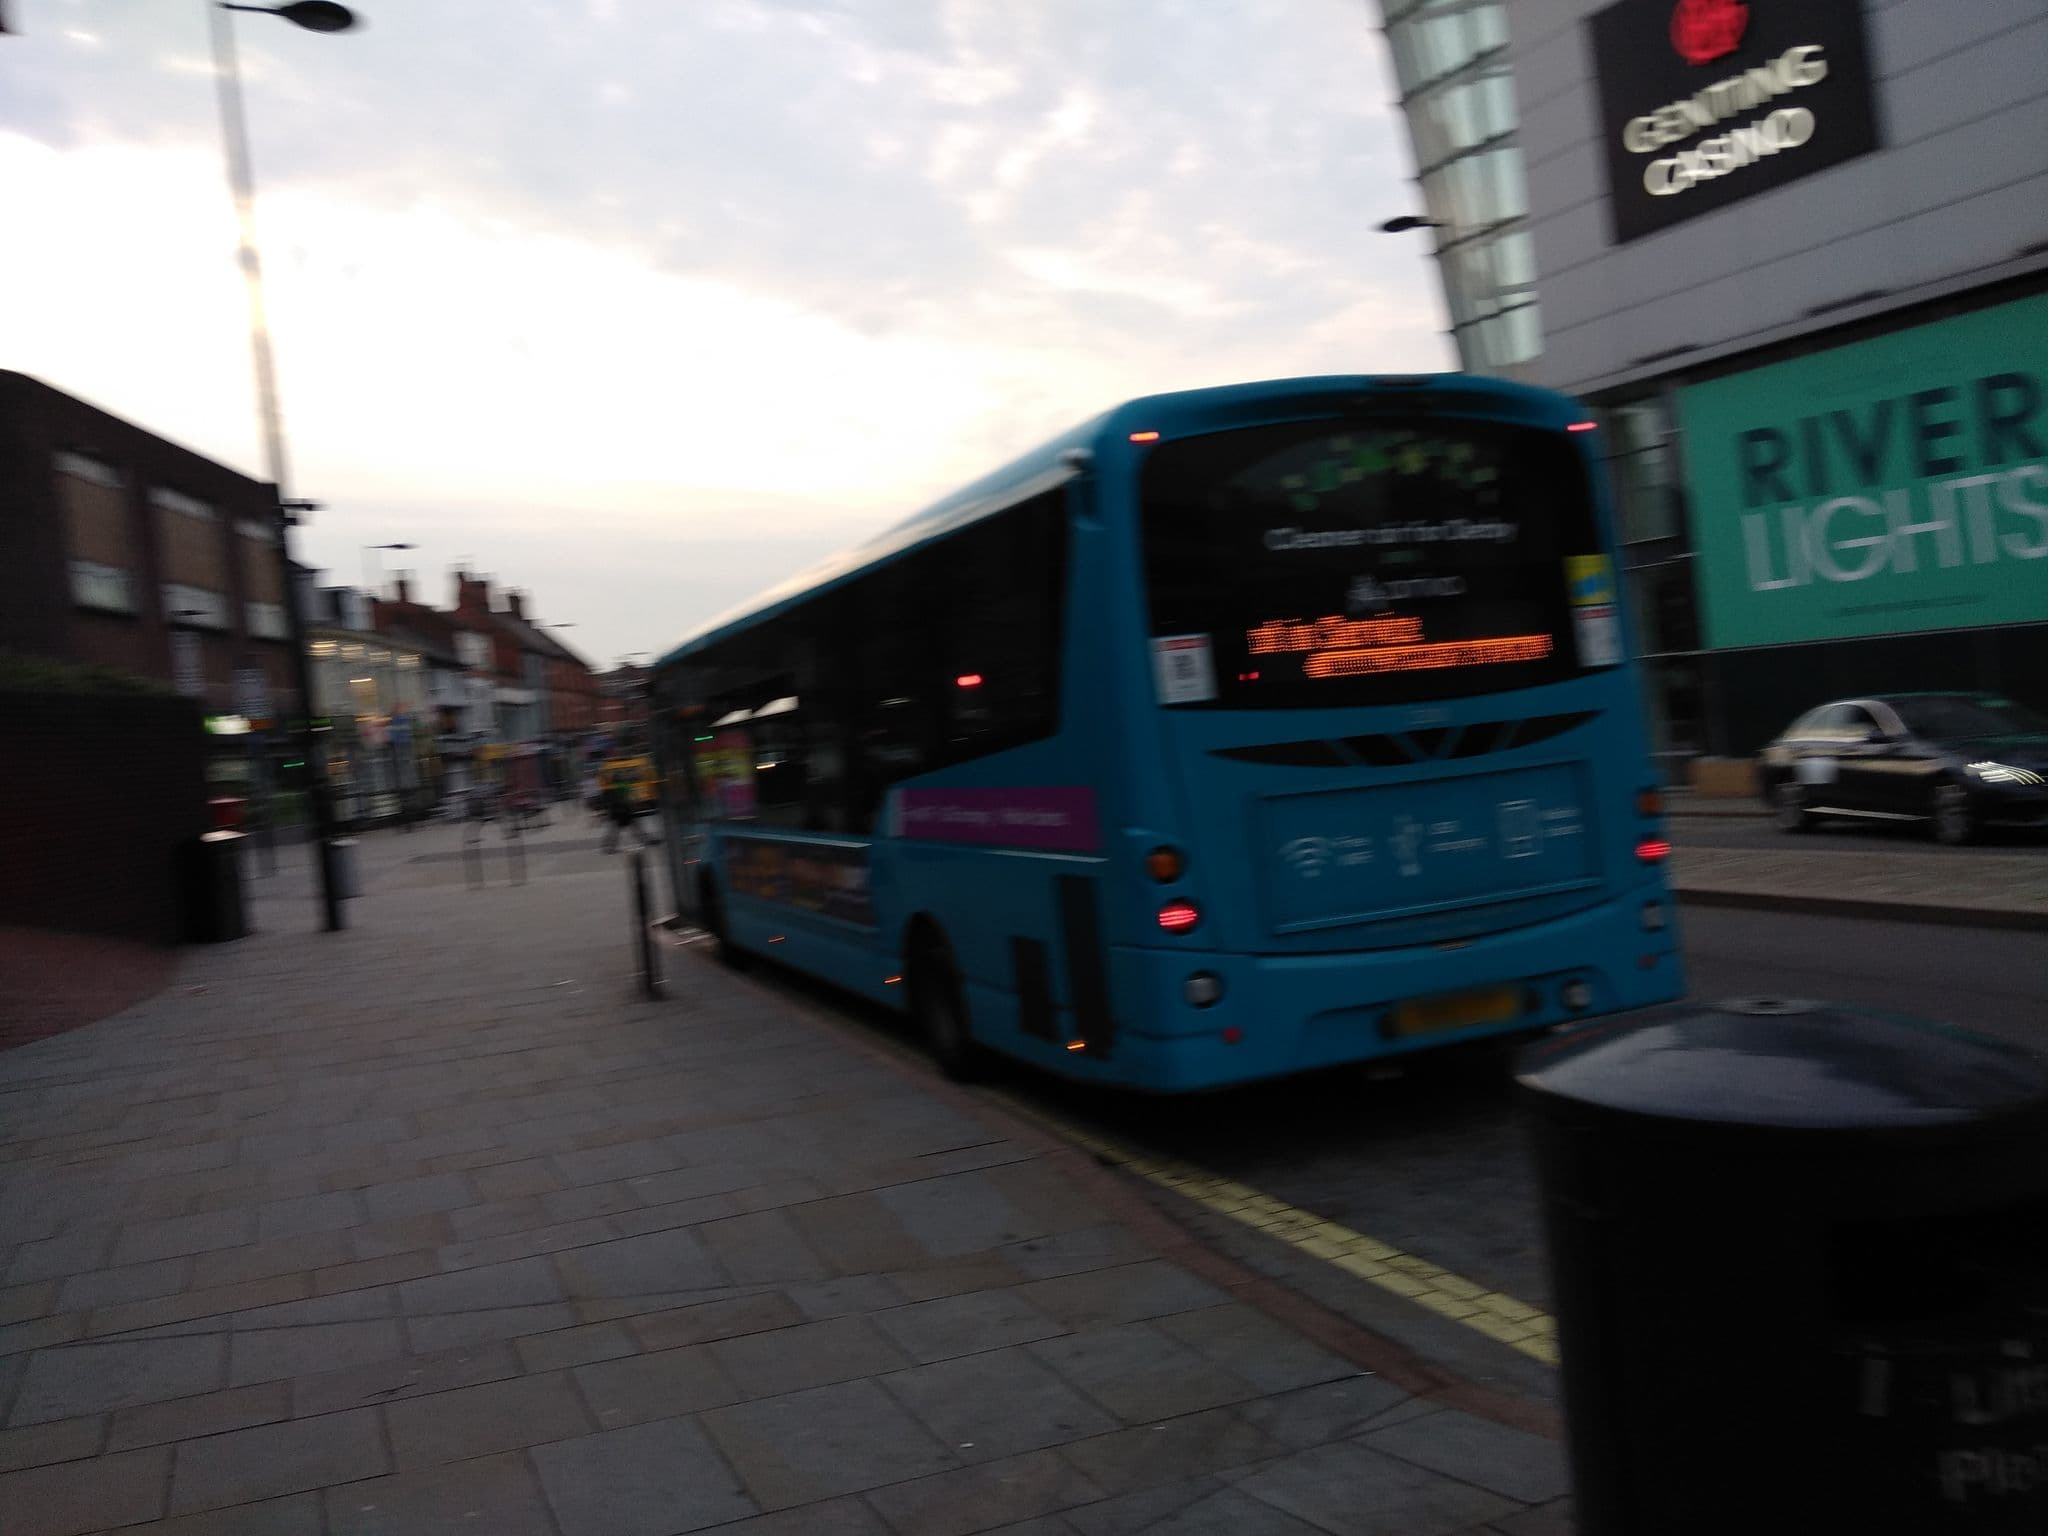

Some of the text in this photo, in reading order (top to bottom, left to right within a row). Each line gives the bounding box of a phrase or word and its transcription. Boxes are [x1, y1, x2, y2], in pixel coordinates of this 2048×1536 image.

[1623, 44, 1828, 153] GENTING
[1643, 106, 1816, 196] CASINO
[1736, 371, 2042, 508] RIVER
[1740, 463, 2048, 592] LIGHTS
